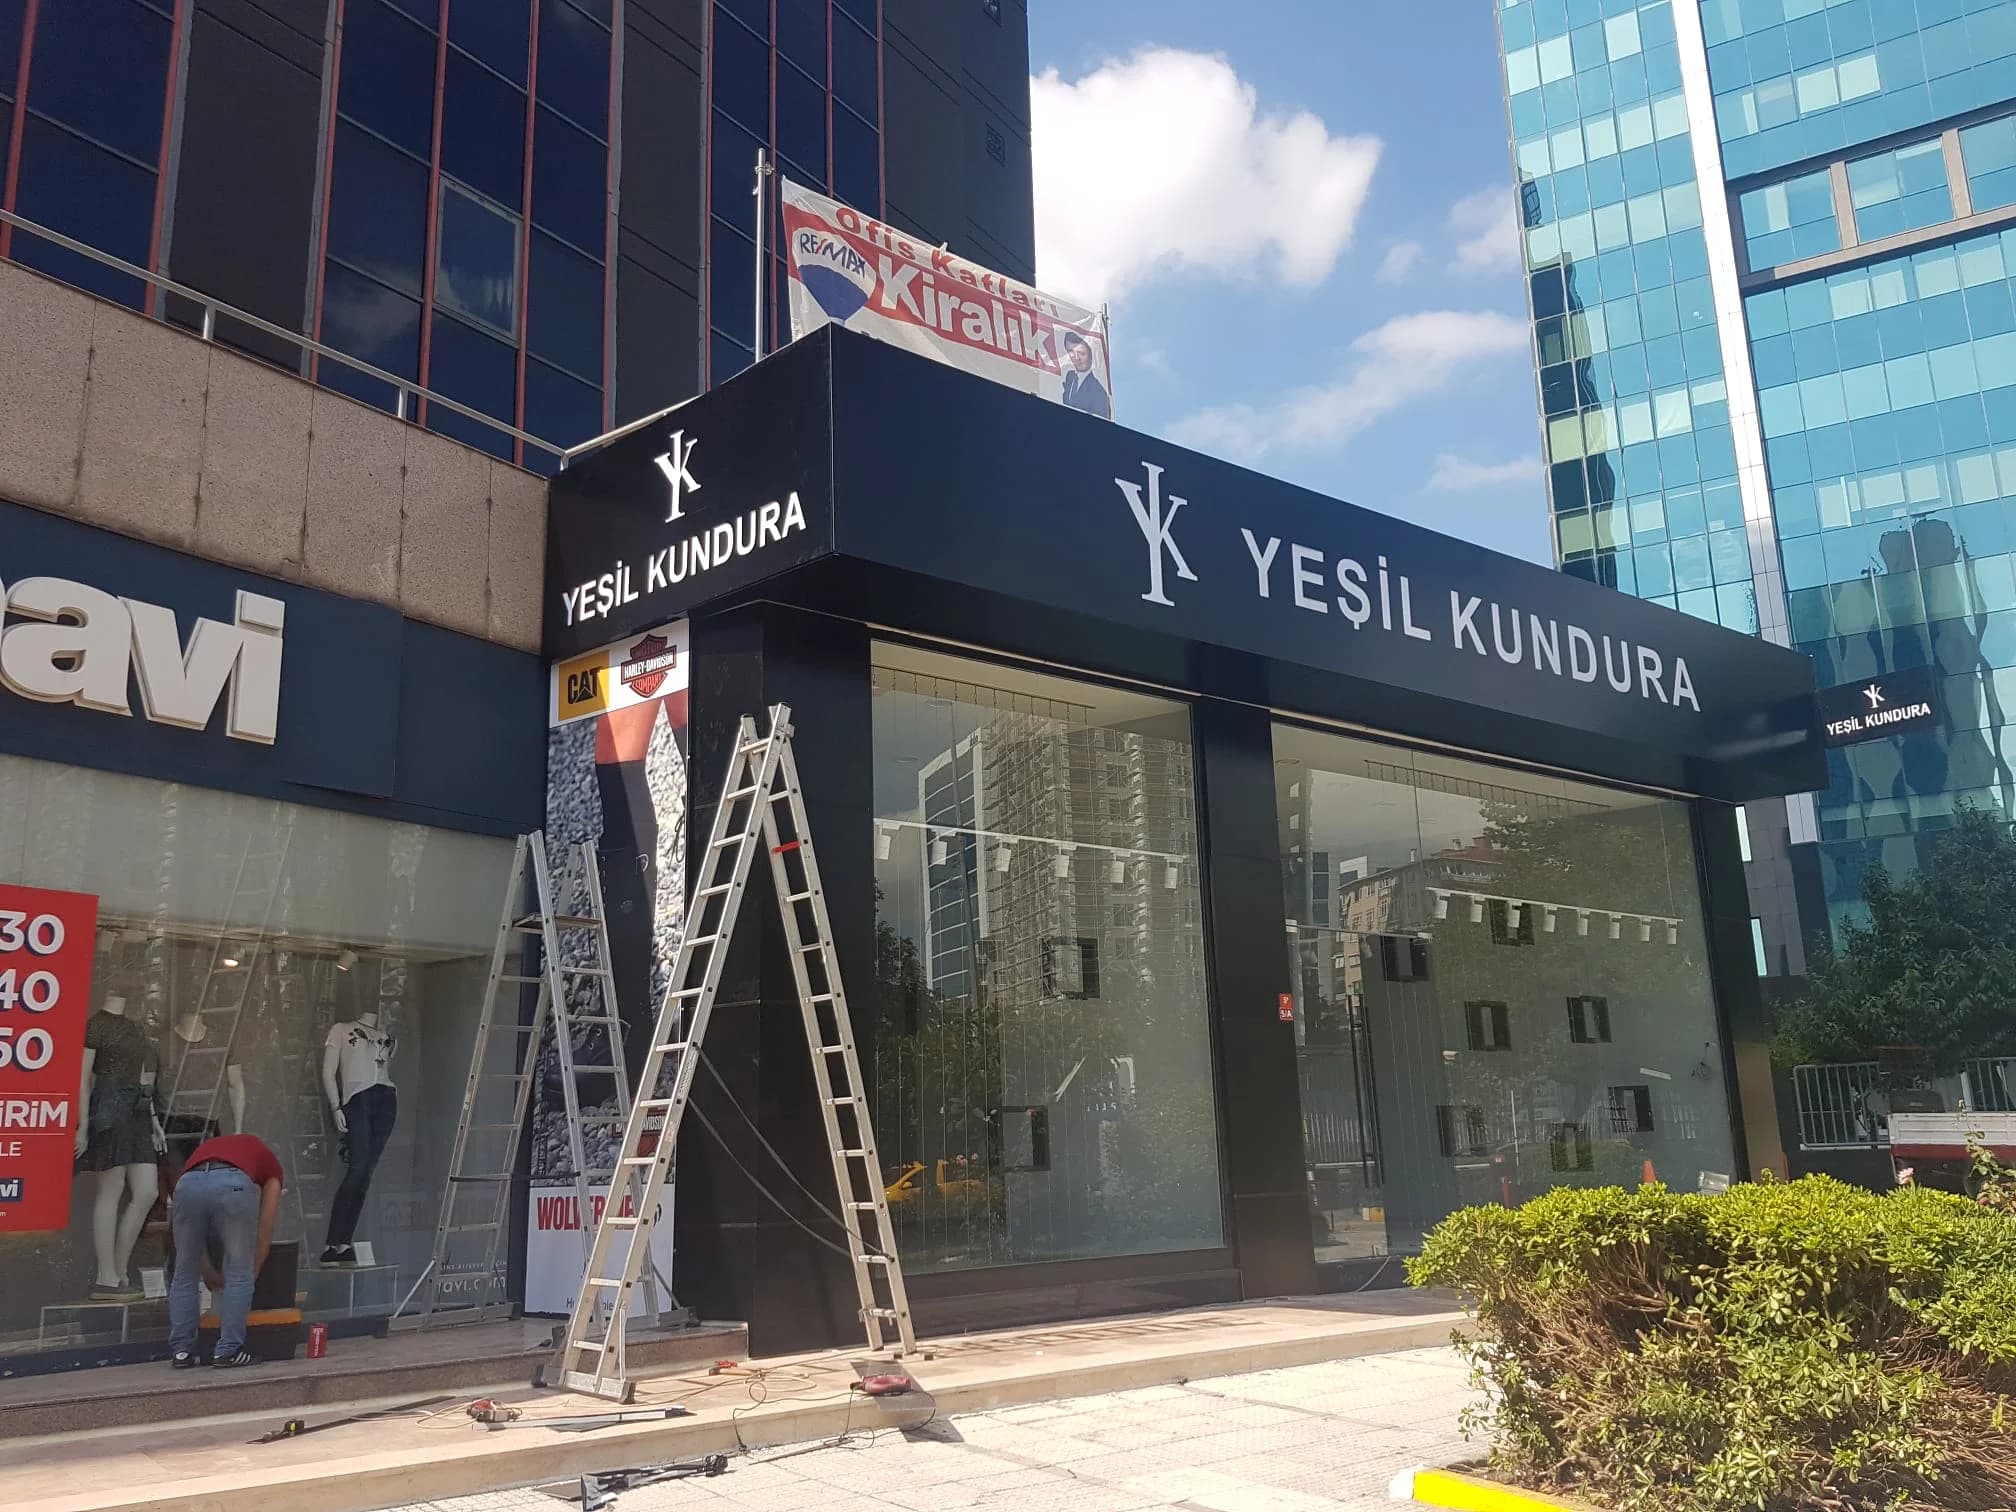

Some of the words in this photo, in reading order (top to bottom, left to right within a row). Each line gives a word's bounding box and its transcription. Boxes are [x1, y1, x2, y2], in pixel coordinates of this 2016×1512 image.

[800, 233, 866, 278] RE/MAX
[836, 207, 916, 260] Ofis
[562, 559, 639, 626] YEŞİL
[647, 491, 807, 593] KUNDURA
[1240, 527, 1431, 642] YEŞİL
[1450, 589, 1702, 712] KUNDURA
[0, 575, 285, 745] avi
[624, 651, 674, 680] HARLEY-DAVIDSON
[567, 666, 601, 705] CAT
[1826, 716, 1863, 736] YEŞİL
[1865, 702, 1931, 728] KUNDURA
[0, 909, 65, 955] 30
[0, 968, 60, 1012] 40
